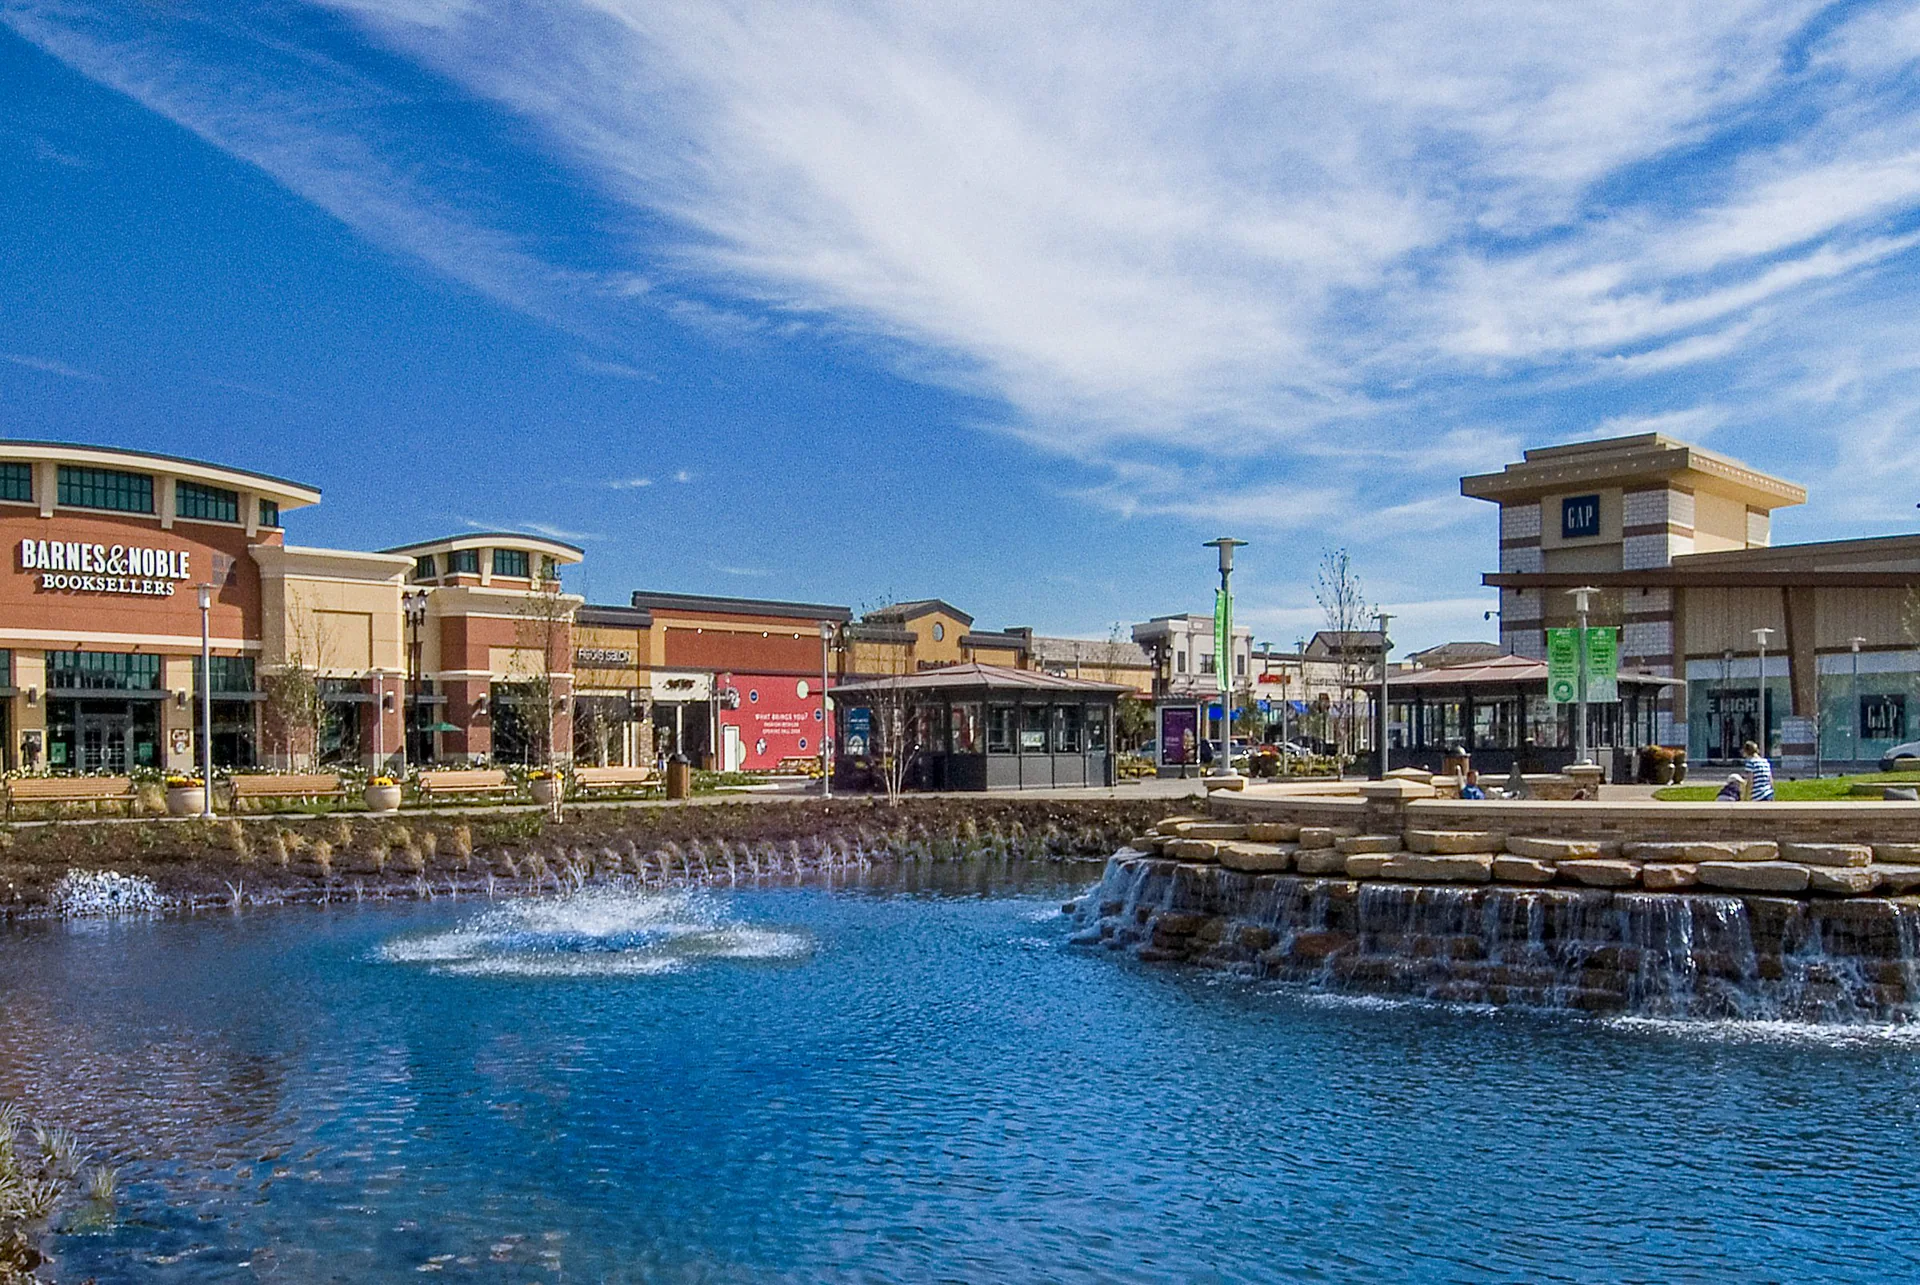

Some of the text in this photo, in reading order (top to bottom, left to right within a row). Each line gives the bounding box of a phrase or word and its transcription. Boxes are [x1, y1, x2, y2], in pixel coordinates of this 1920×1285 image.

[1567, 504, 1593, 529] GAP
[22, 538, 191, 579] BARNES&NOBLE
[42, 573, 175, 596] BOOKSELLERS
[1867, 704, 1897, 729] GAP
